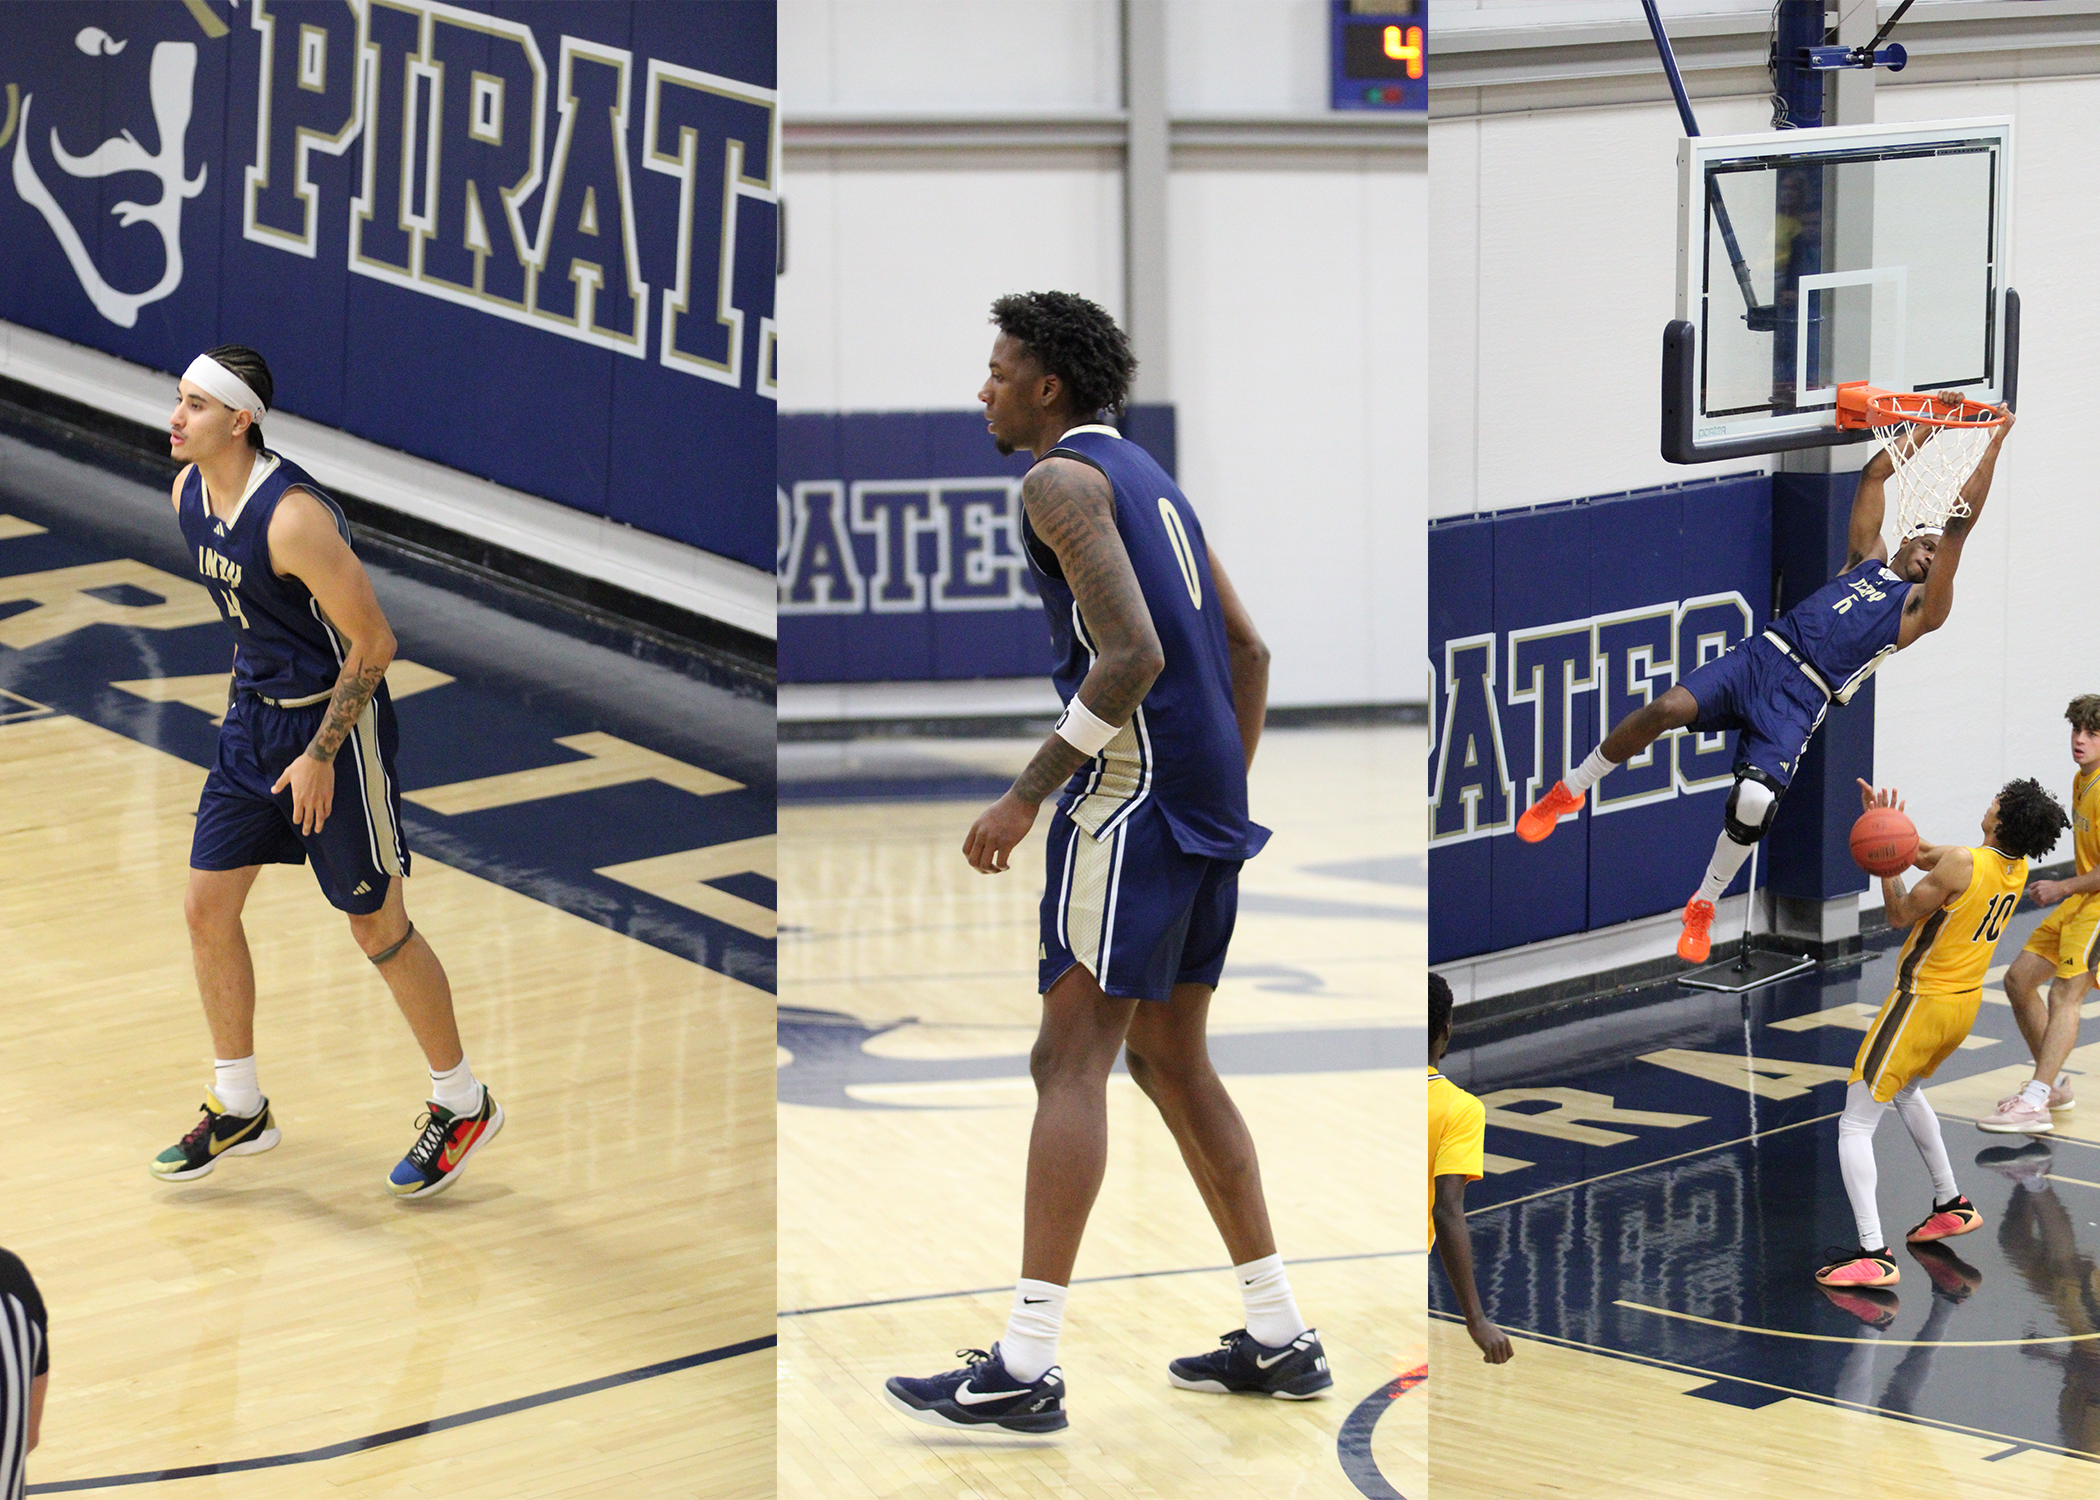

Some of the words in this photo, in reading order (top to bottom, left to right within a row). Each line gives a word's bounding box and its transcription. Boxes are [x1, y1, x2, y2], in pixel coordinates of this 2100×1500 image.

[1383, 25, 1423, 80] 4
[243, 0, 777, 400] PIRAT
[198, 545, 242, 589] INDY
[777, 476, 1044, 615] ATE
[1158, 497, 1202, 611] 0
[1971, 892, 2017, 943] 10
